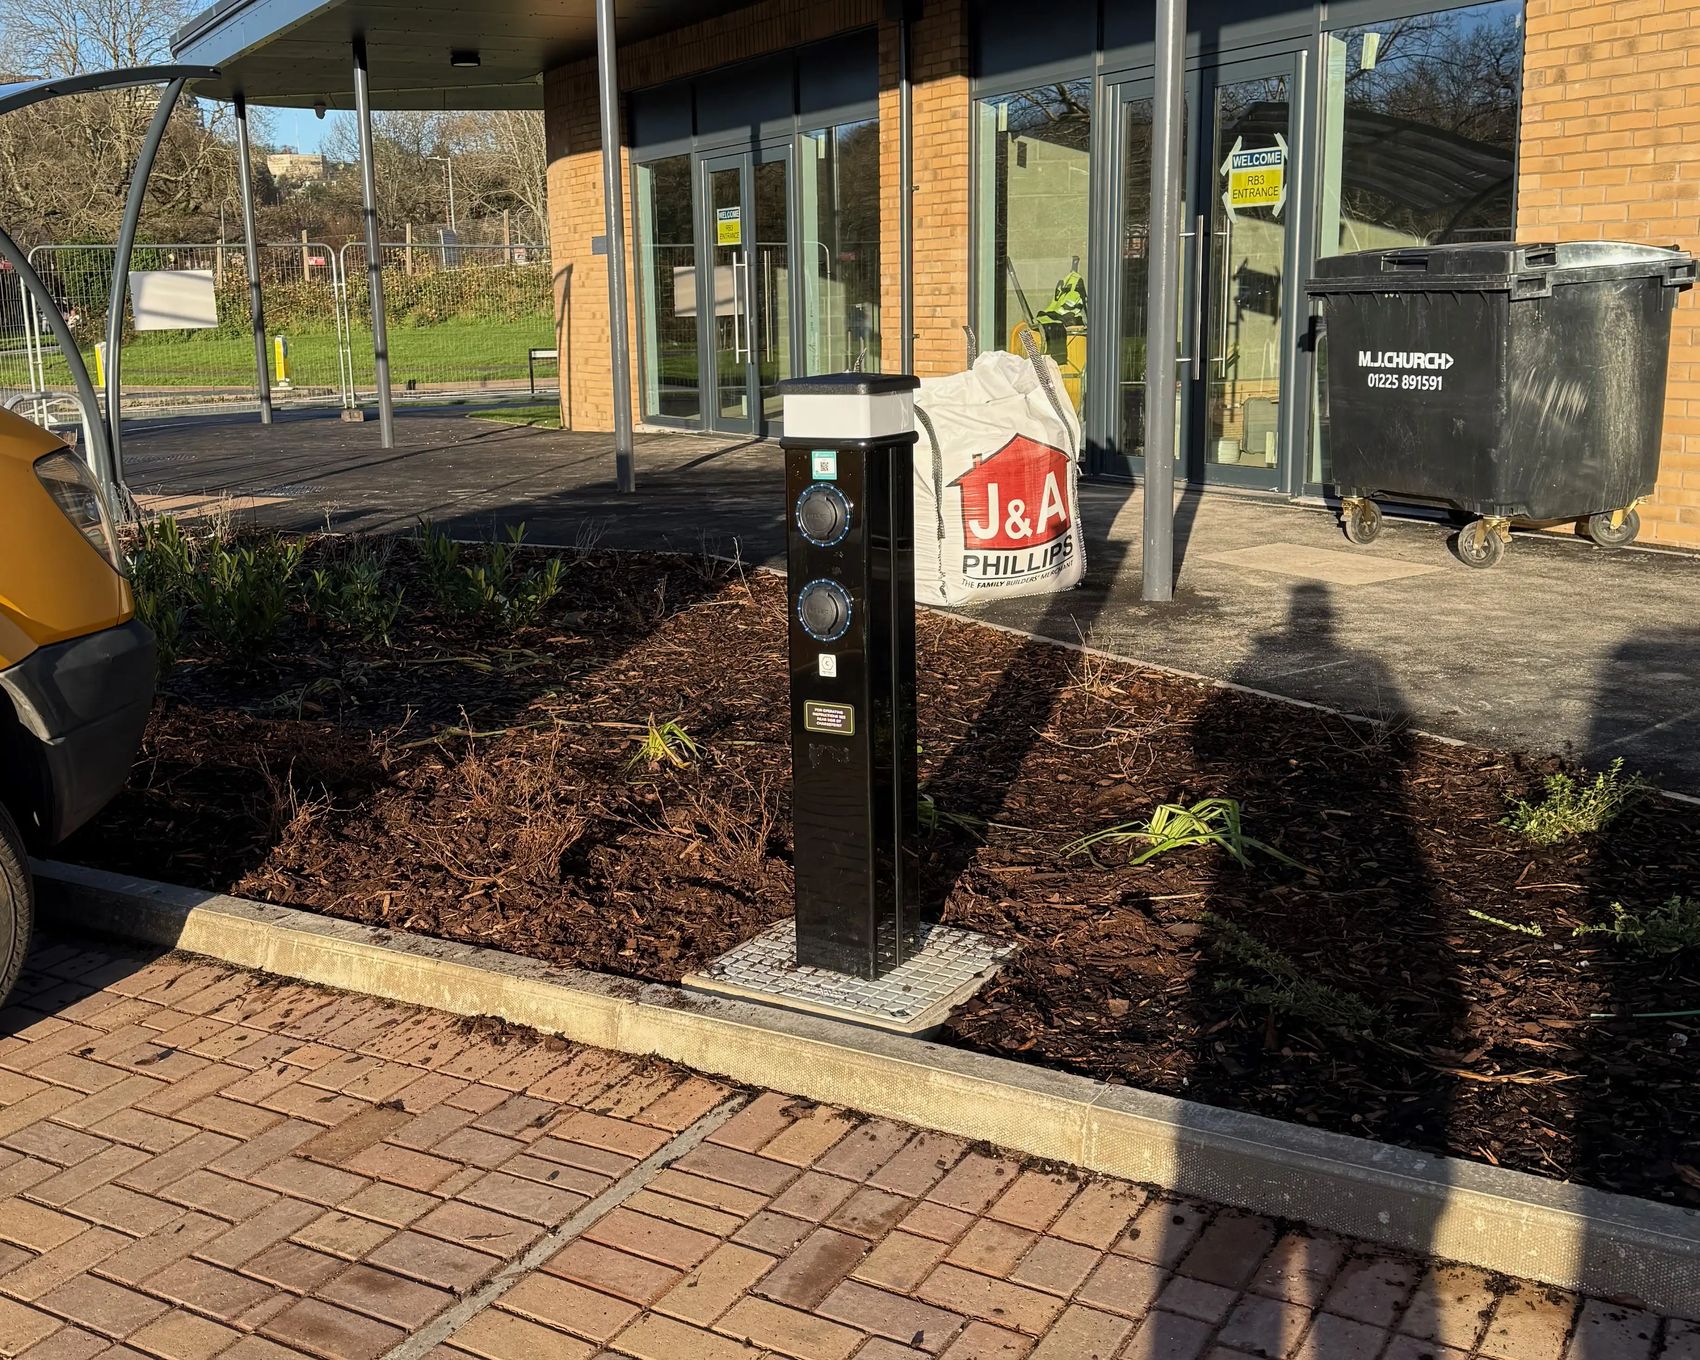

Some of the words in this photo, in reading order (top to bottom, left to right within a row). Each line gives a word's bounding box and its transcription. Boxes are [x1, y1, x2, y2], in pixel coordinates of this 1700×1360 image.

[1233, 151, 1281, 167] WELCOME
[1247, 174, 1265, 186] RB3
[1232, 186, 1279, 199] ENTRANCE
[1367, 373, 1399, 389] 01225
[1401, 374, 1443, 391] 891591
[962, 534, 1074, 576] PHILLIPS
[961, 578, 975, 589] THE
[976, 580, 1005, 589] FAMILY
